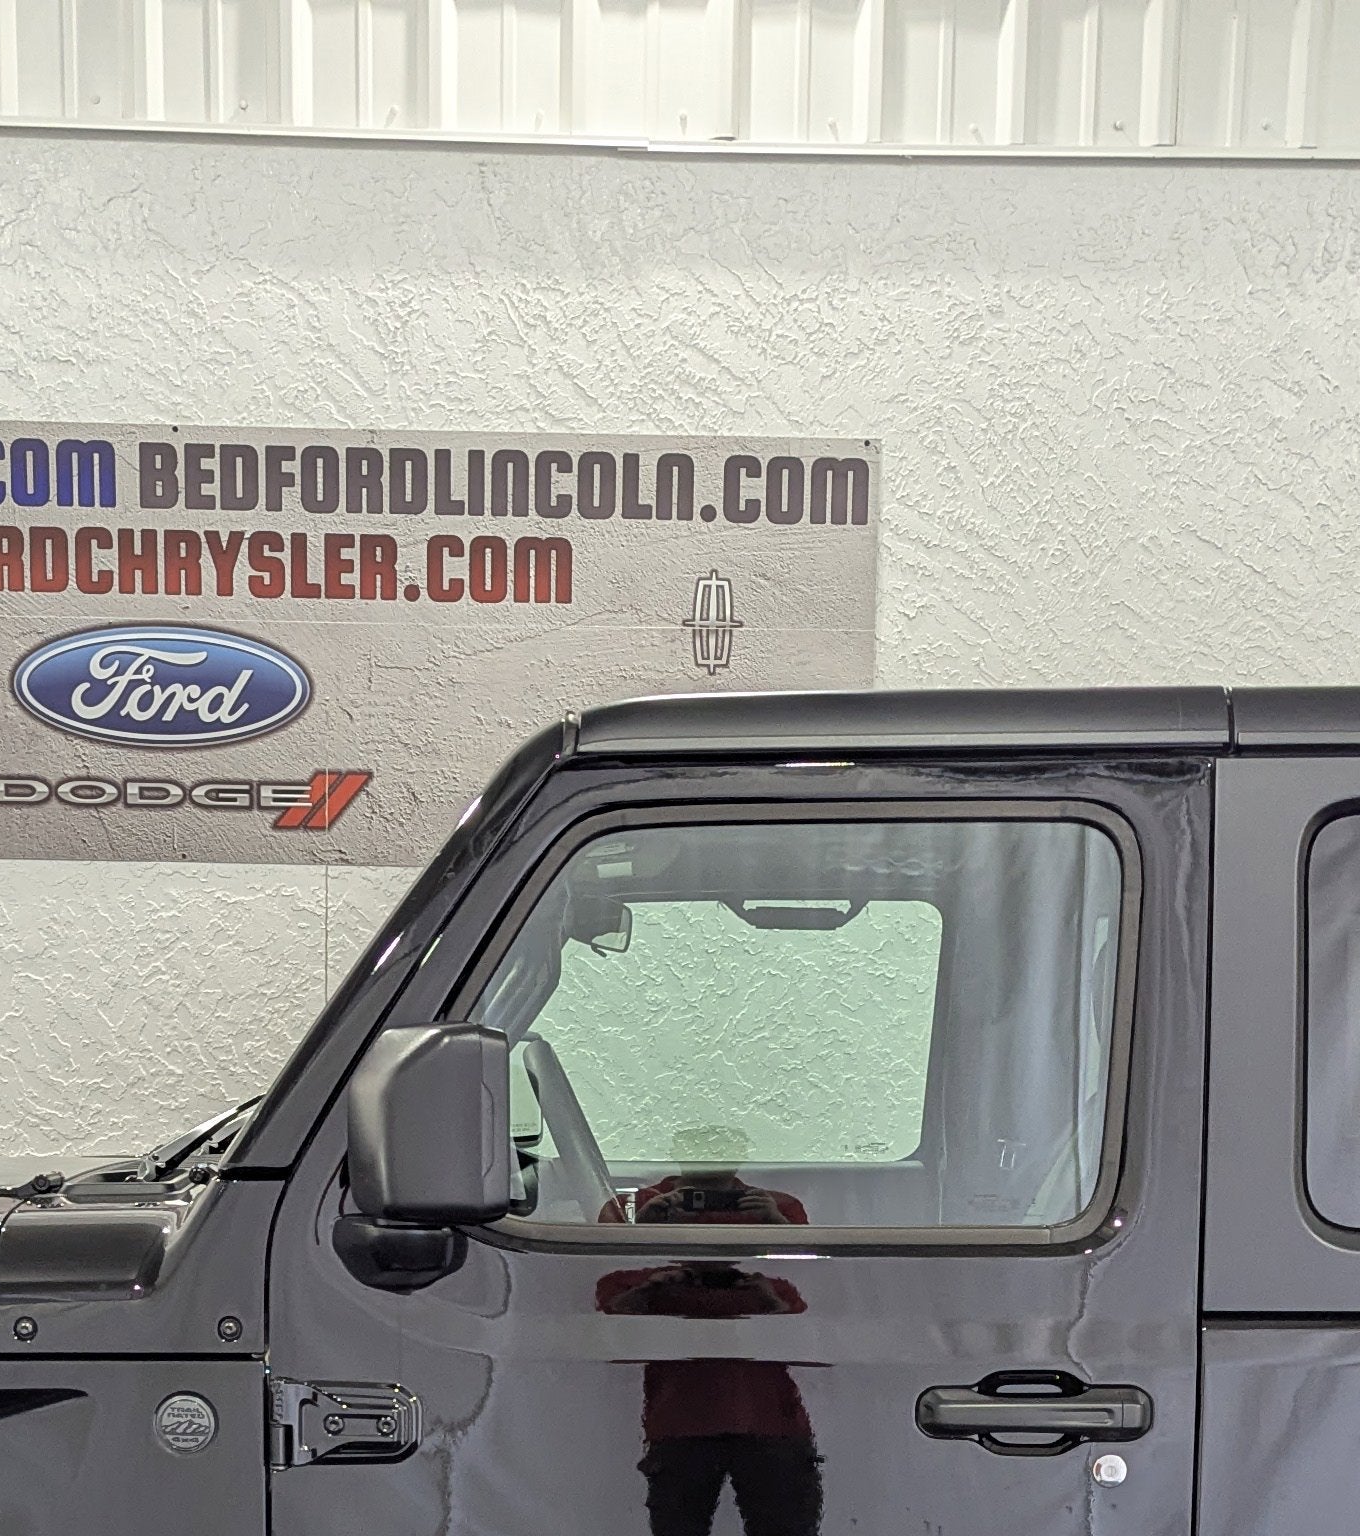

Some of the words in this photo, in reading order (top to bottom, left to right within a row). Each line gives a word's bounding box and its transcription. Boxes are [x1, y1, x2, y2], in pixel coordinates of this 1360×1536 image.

[138, 441, 869, 526] BEDFORDLINCOLN.COM
[70, 646, 253, 722] Ford
[169, 1406, 200, 1414] TRAIL
